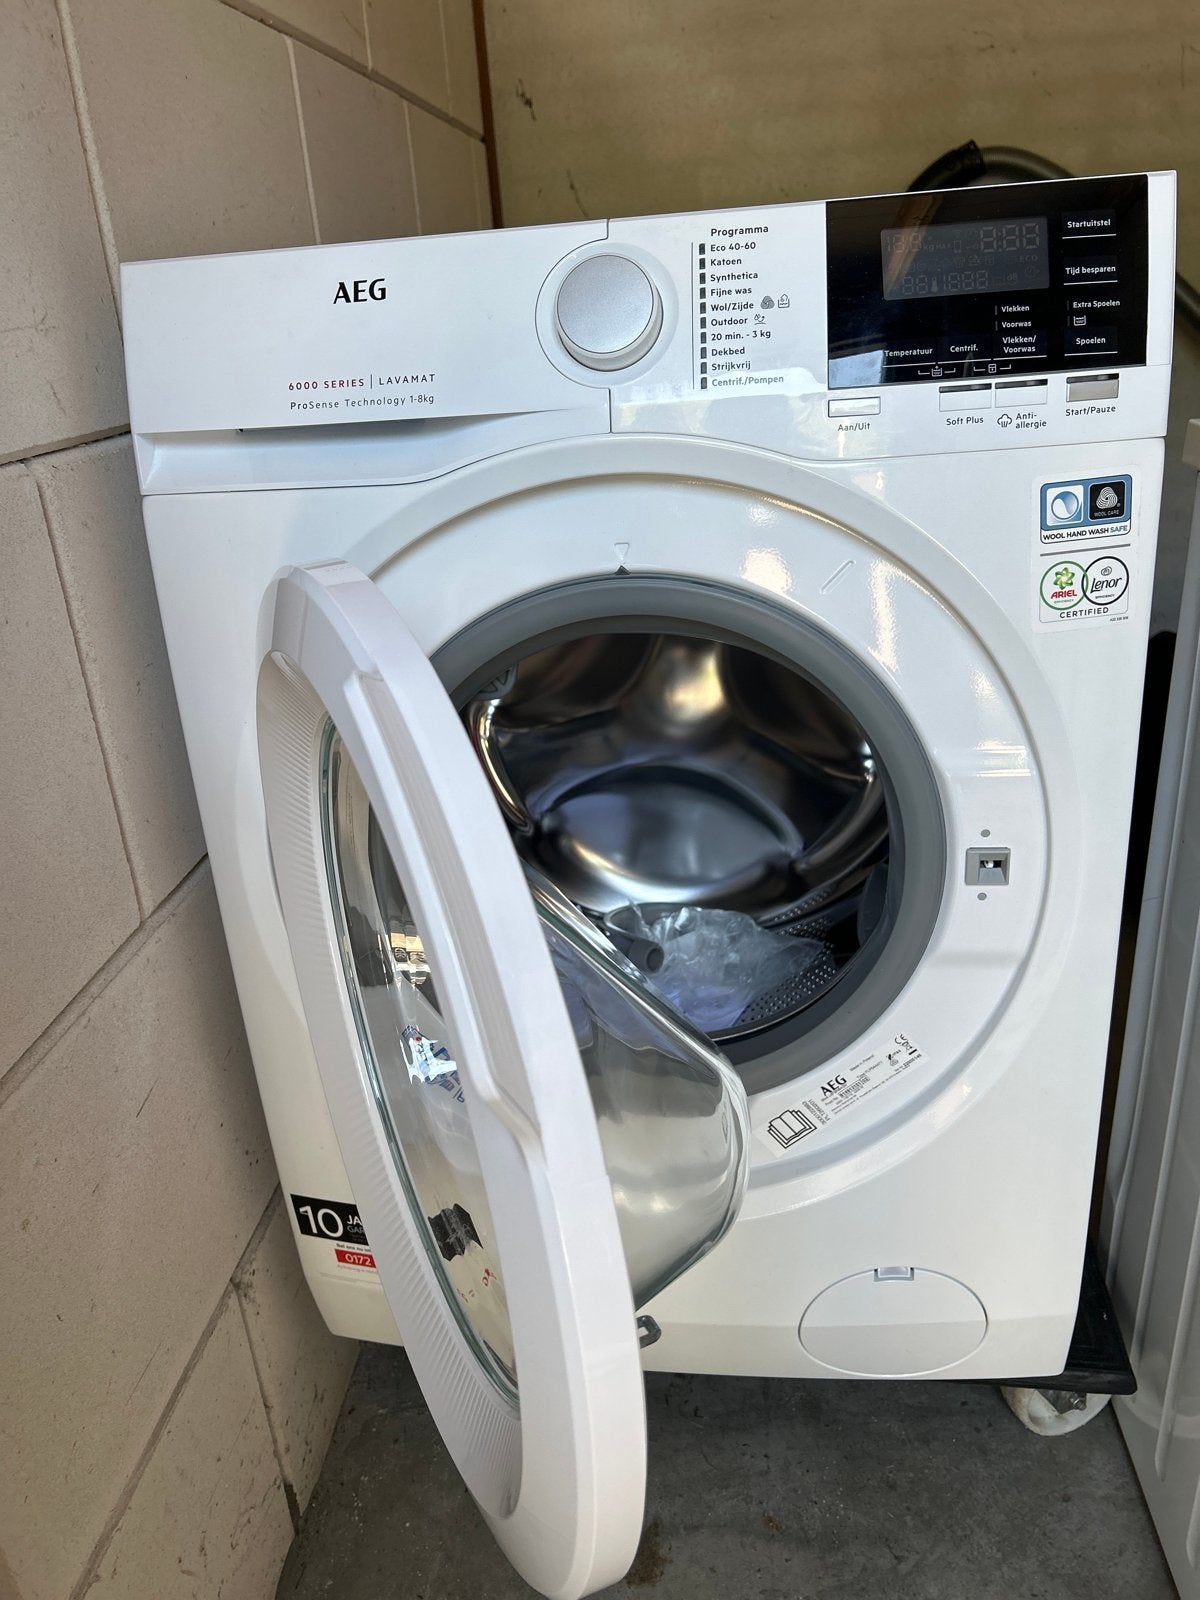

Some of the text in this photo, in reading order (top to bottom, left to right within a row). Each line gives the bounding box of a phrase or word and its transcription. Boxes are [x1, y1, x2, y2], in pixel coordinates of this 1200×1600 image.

[1067, 218, 1111, 228] Startuitstel
[710, 225, 769, 237] Programma
[710, 242, 756, 252] Eco 40-60
[710, 258, 742, 266] Katoen
[1065, 265, 1116, 276] Tijd besparen
[710, 272, 759, 283] Synthetica
[333, 278, 387, 304] AEG
[710, 287, 752, 297] Fijne was
[710, 302, 754, 312] Wol/Zijde
[1001, 304, 1030, 313] Vlekken
[1073, 299, 1121, 309] Extra Spoelen
[711, 317, 748, 327] Outdoor
[1001, 320, 1032, 329] Voorwas
[711, 333, 722, 341] 20
[724, 332, 744, 340] min.
[752, 331, 758, 339] 3
[760, 330, 771, 340] kg
[1002, 335, 1037, 344] Vlekken/
[1075, 336, 1106, 346] Spoelen
[711, 347, 746, 356] Dekbed
[884, 348, 933, 359] Temperatuur
[950, 344, 978, 353] Centrif.
[1003, 345, 1036, 354] Voorwas
[711, 361, 751, 371] Strijkvrij
[288, 374, 436, 391] 6000 SERIES LAVAMAT
[712, 375, 784, 387] Centrif./Pompen
[290, 394, 434, 410] ProSense Technology 1-8kg
[1065, 405, 1116, 417] Start/Pauze
[946, 415, 984, 425] Soft Plus
[1016, 412, 1037, 421] Anti-
[837, 423, 870, 432] Aan/Uit
[1015, 419, 1047, 430] allergie
[1043, 525, 1128, 541] WOOL HAND WASH SAFE
[1090, 577, 1122, 594] Lenor
[1051, 589, 1078, 600] ARIEL
[1060, 607, 1109, 619] CERTIFIED
[820, 1074, 847, 1097] AEG
[299, 1205, 344, 1238] 10
[345, 1254, 372, 1265] 0172
